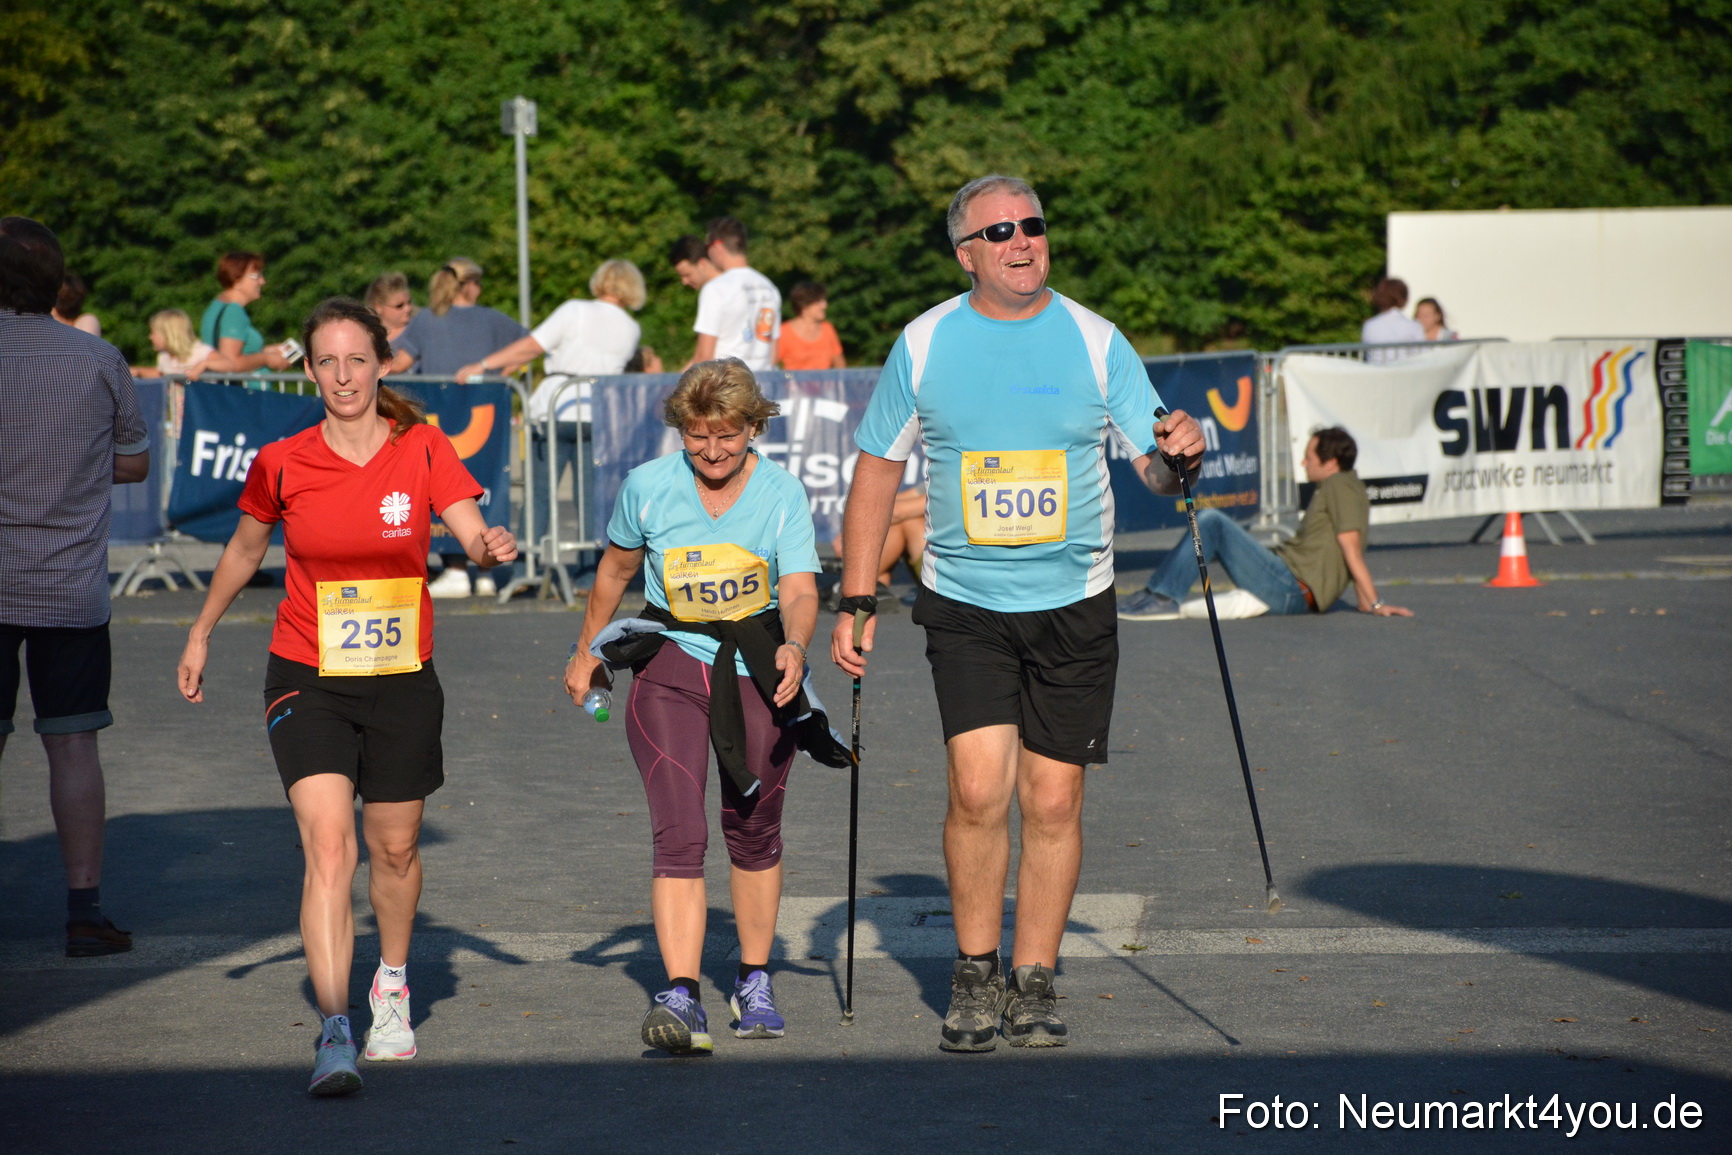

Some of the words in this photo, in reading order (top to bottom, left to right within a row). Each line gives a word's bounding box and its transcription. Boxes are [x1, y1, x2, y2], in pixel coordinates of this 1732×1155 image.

[1433, 384, 1570, 457] swn
[191, 430, 260, 480] Fris
[976, 466, 1014, 475] firmenlauf
[1532, 460, 1614, 486] neumarkt
[967, 476, 997, 485] walken
[974, 487, 1057, 518] 1506
[382, 527, 412, 538] caritas
[1015, 524, 1033, 532] Weigl
[670, 571, 699, 580] walken
[678, 573, 760, 605] 1505
[334, 595, 373, 605] firmenlauf
[324, 607, 355, 616] walken
[340, 616, 402, 649] 255
[364, 654, 399, 663] Champagne
